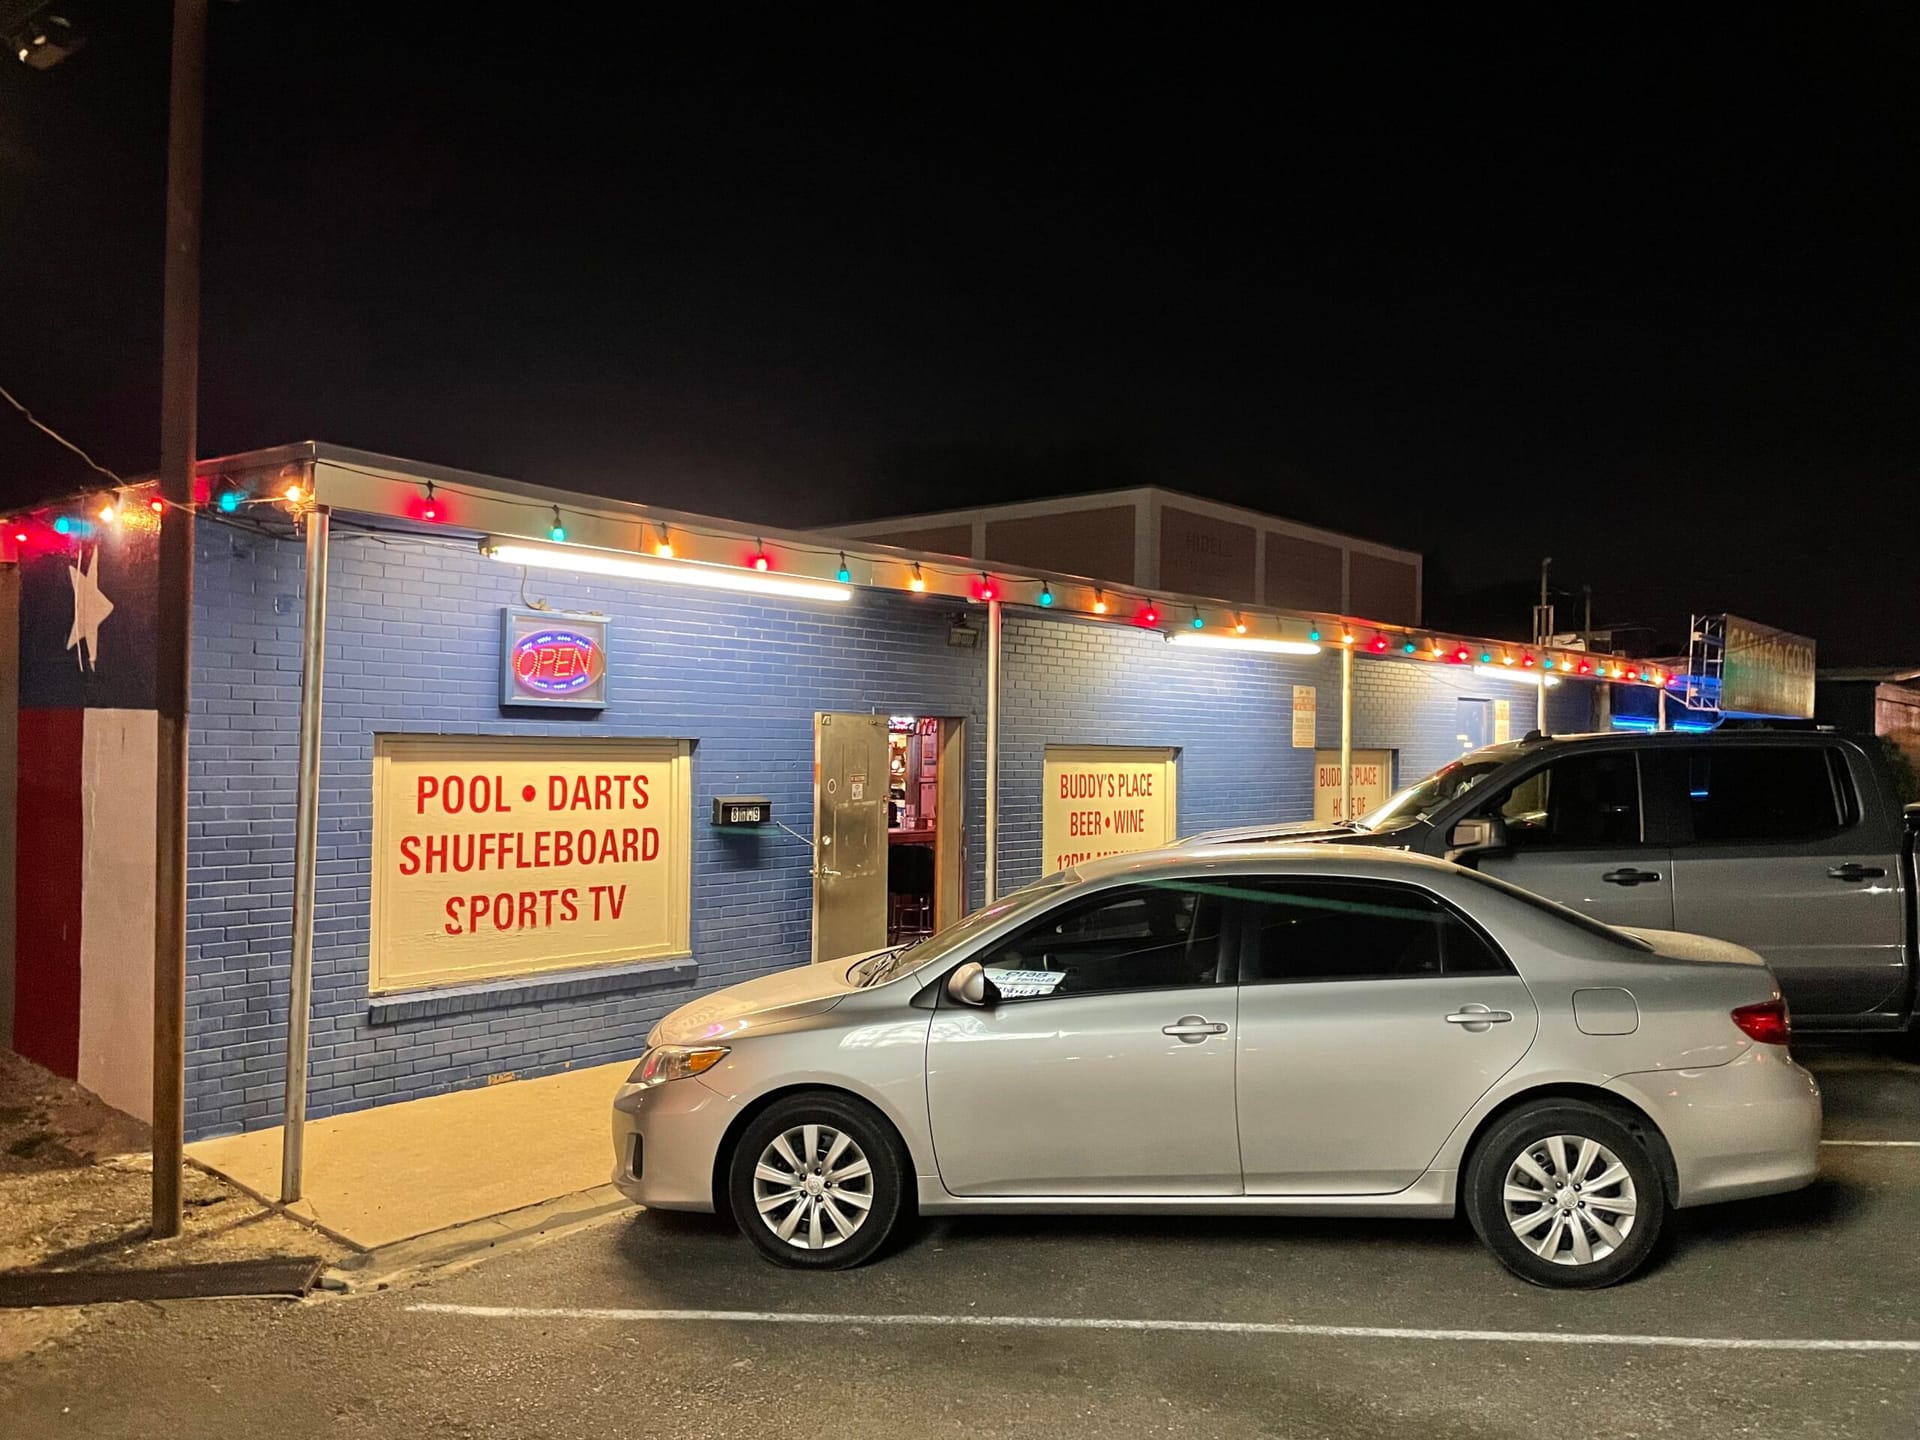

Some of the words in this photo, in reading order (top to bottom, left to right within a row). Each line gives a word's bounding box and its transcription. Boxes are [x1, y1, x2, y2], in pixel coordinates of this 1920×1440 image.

[516, 646, 592, 679] OPEN
[1060, 774, 1115, 800] BUDDY'S
[1118, 773, 1153, 798] PLACE
[1356, 766, 1377, 786] PLACE
[417, 775, 512, 815] POOL
[549, 775, 650, 812] DARTS
[1333, 798, 1355, 820] HOE
[1357, 797, 1366, 816] OF
[1070, 812, 1101, 837] BEER
[1114, 809, 1145, 834] WINE
[400, 827, 660, 876] SHUFFLEBOARD
[445, 887, 579, 936] SPORTS
[589, 885, 627, 922] TV
